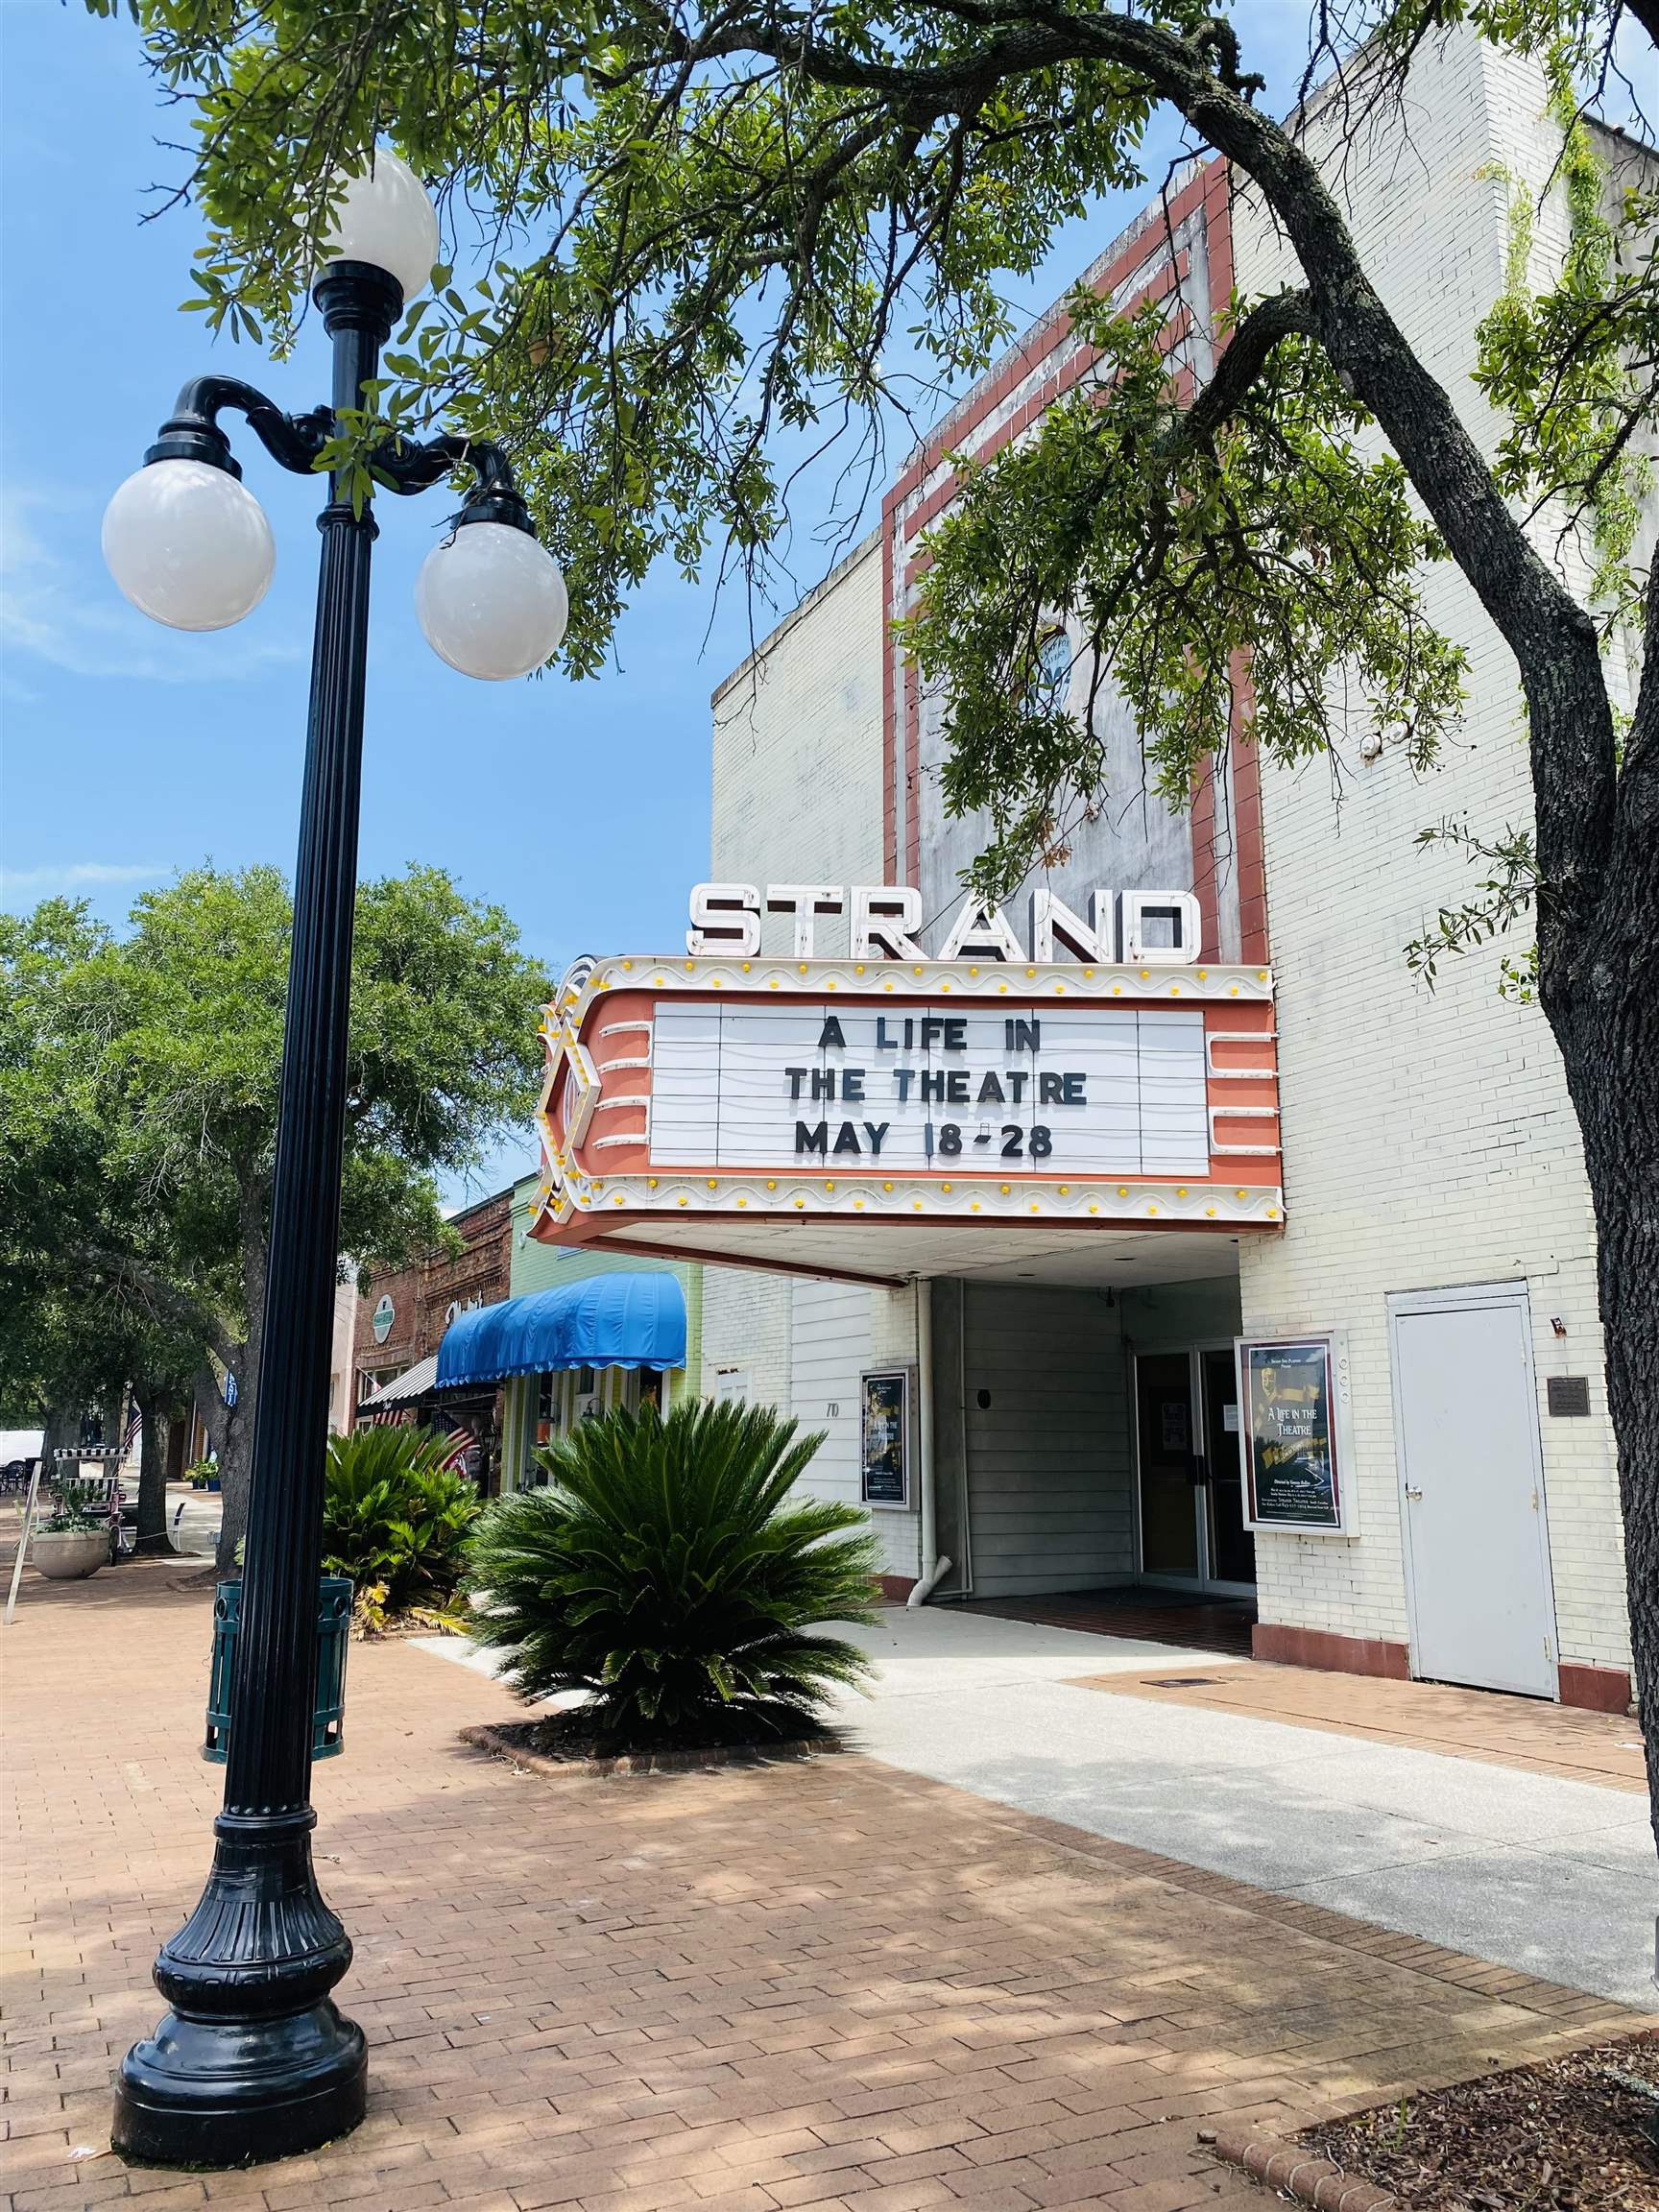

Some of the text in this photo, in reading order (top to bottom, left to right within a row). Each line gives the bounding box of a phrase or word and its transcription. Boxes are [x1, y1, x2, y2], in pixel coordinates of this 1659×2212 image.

[685, 882, 1202, 965] STRAND
[818, 1016, 1040, 1051] A LIFE IN
[784, 1068, 1088, 1105] THE THEATRE
[795, 1120, 1053, 1158] MAY 18-28
[1301, 1408, 1317, 1420] THE
